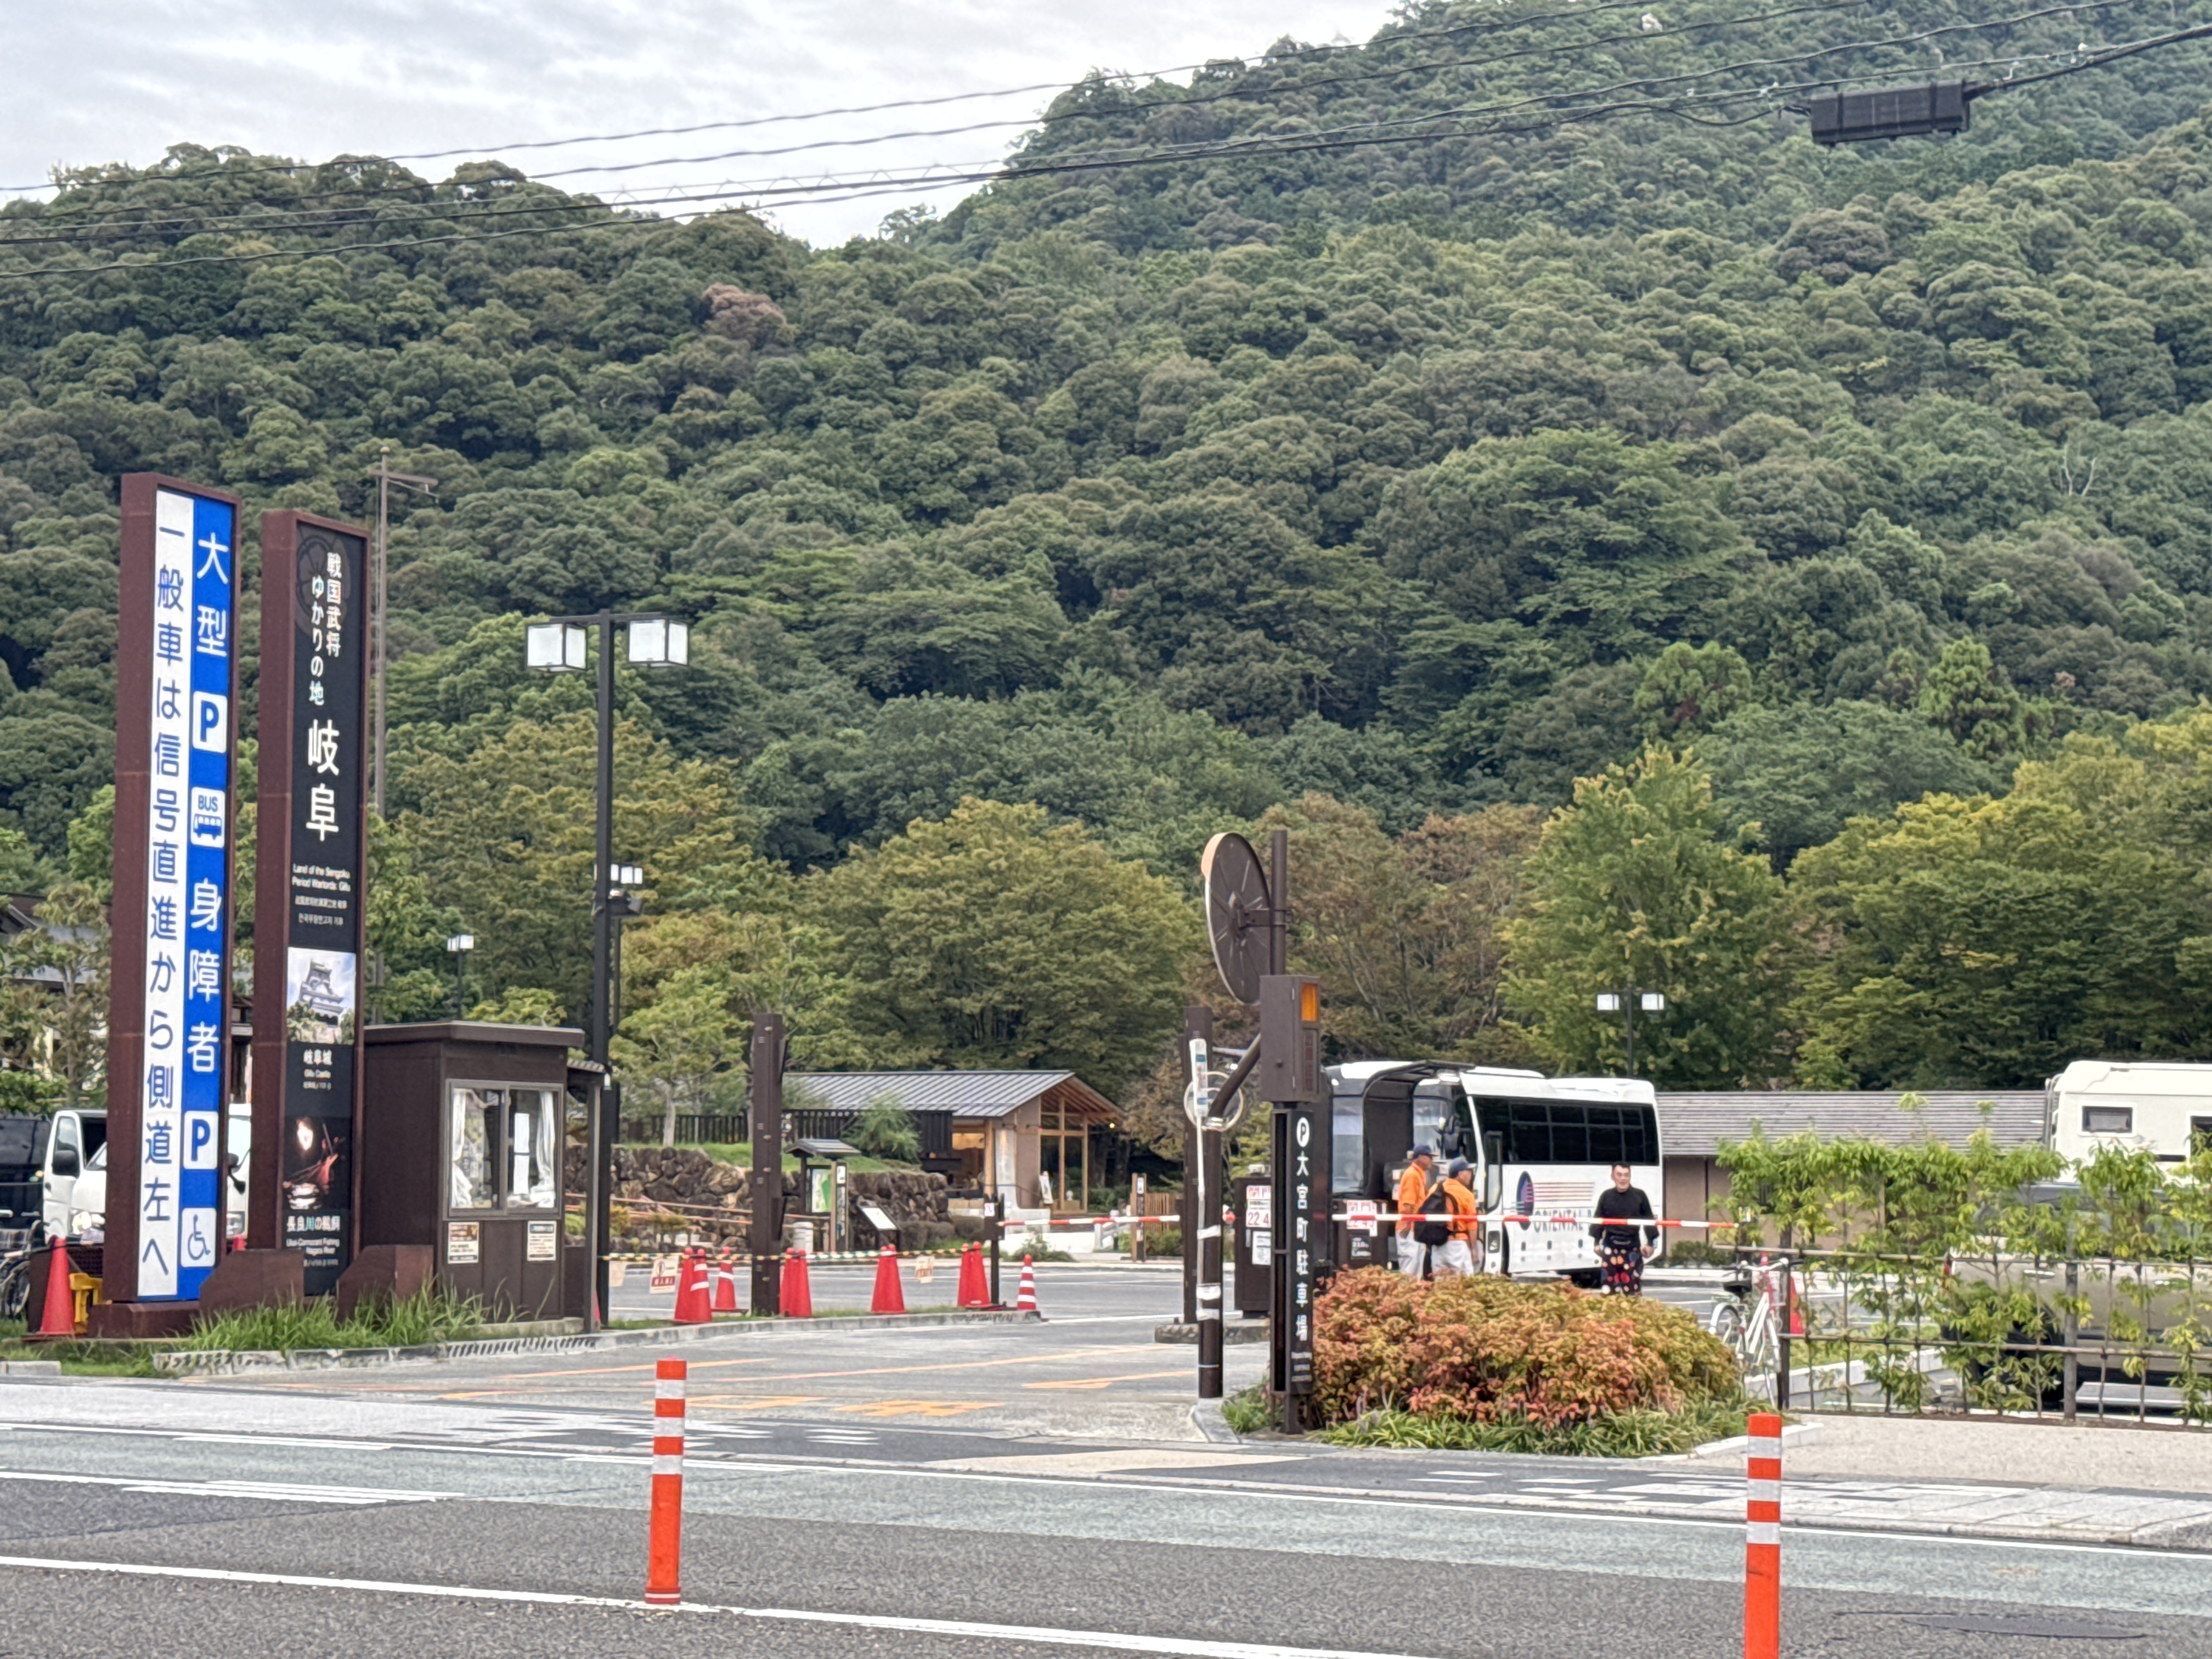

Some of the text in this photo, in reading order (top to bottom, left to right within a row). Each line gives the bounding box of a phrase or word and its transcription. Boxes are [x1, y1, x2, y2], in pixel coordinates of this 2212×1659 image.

[196, 532, 229, 657] 大型
[309, 574, 325, 706] ゆかりの地
[200, 699, 219, 742] P
[306, 719, 340, 842] 岐阜
[198, 794, 218, 812] BUS
[142, 526, 185, 1276] 一般車は信号直進から側道左へ
[187, 877, 222, 1073] 身障者
[191, 1119, 210, 1161] P
[1534, 1209, 1584, 1233] ORIENTAL
